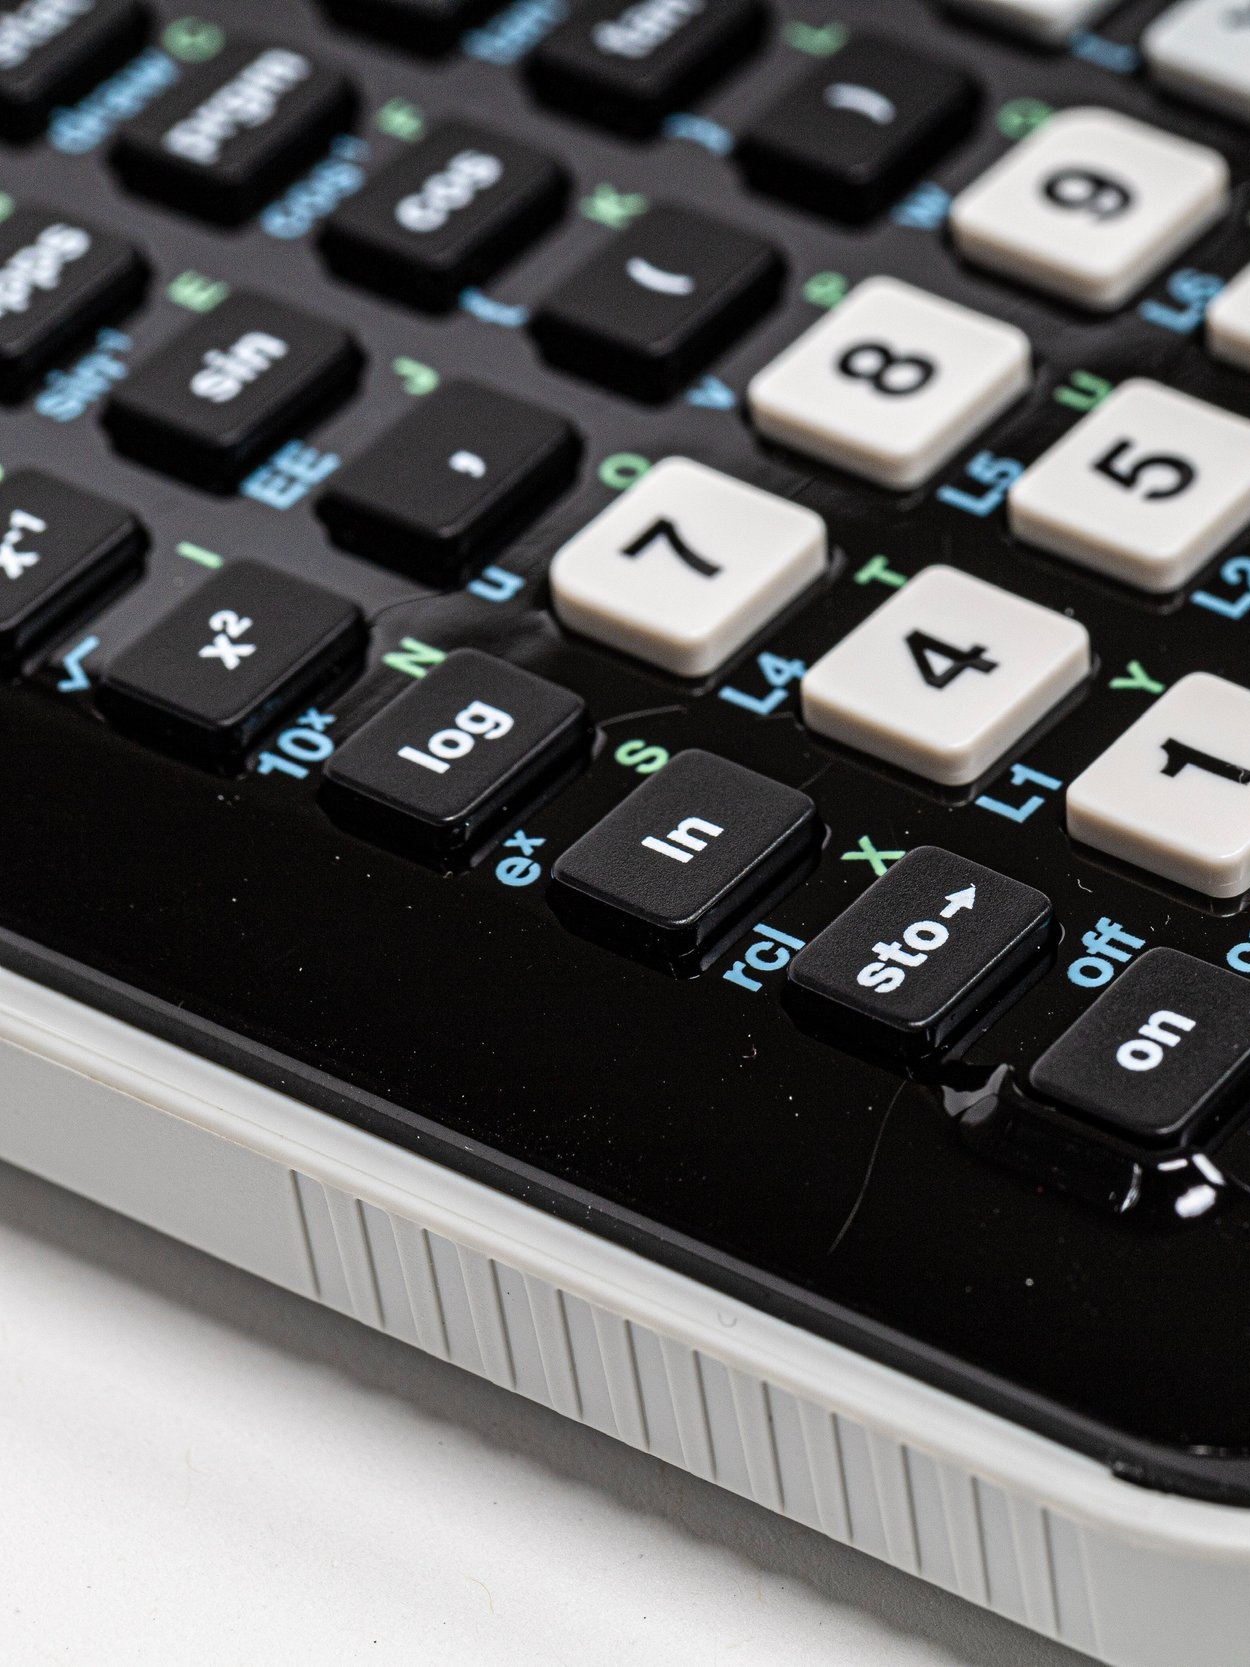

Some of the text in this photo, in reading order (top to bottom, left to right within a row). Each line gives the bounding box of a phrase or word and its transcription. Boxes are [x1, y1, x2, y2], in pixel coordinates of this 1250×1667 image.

[398, 154, 499, 230] cos
[1039, 168, 1137, 220] 9
[168, 272, 225, 312] E
[1142, 271, 1225, 332] L6
[192, 333, 285, 401] sin
[394, 358, 438, 395] J
[837, 343, 936, 396] 8
[1058, 373, 1112, 411] U
[241, 440, 339, 509] EE
[938, 453, 1024, 516] L5
[1093, 440, 1195, 500] 5
[622, 518, 720, 577] 7
[855, 556, 907, 588] T
[384, 639, 446, 678] N
[720, 652, 807, 714] L4
[905, 630, 998, 689] 4
[1111, 661, 1164, 694] Y
[398, 701, 514, 773] log
[616, 740, 669, 774] S
[976, 764, 1062, 821] L1
[641, 817, 724, 863] ln
[841, 835, 906, 877] X
[724, 923, 805, 991] rcl
[1068, 916, 1144, 987] off
[1117, 1011, 1196, 1071] on
